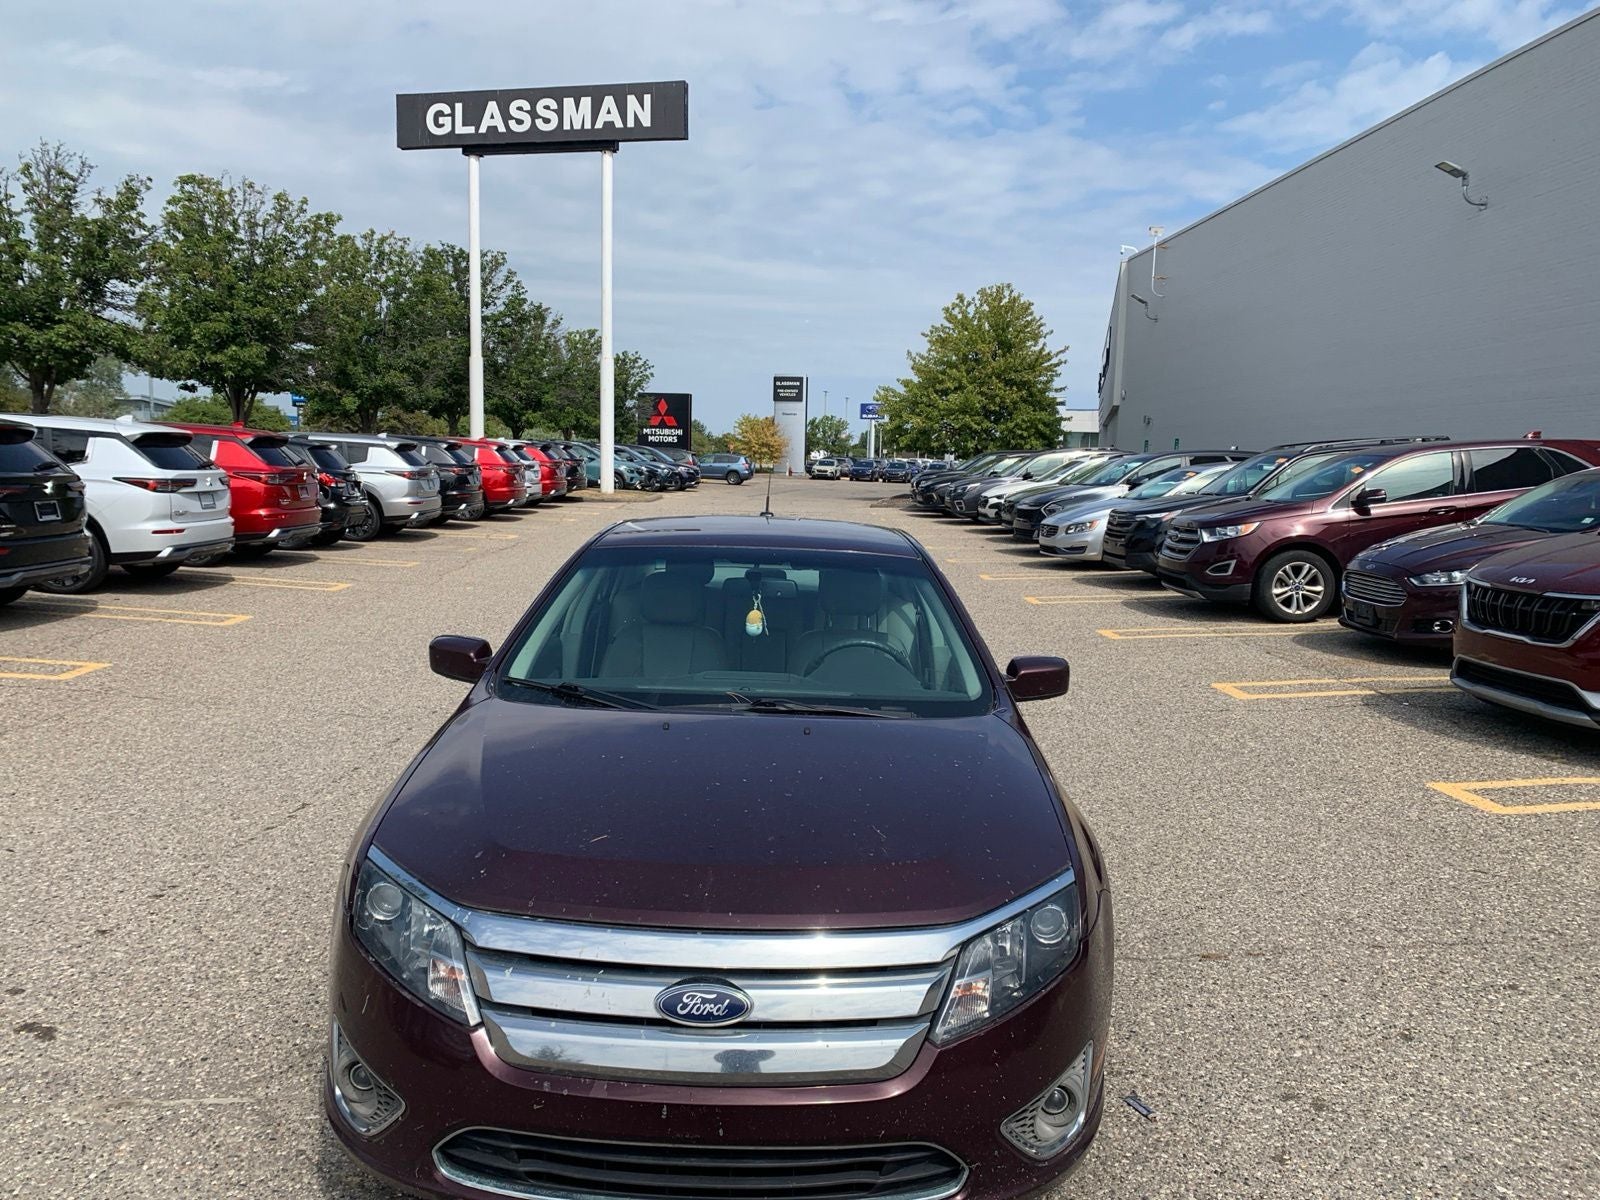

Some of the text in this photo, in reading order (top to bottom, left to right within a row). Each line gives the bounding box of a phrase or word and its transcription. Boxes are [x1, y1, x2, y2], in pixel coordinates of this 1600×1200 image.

[425, 93, 652, 136] GLASSMAN
[643, 428, 683, 436] MITSUBISHI
[648, 435, 678, 443] MOTORS
[676, 992, 730, 1016] Ford
